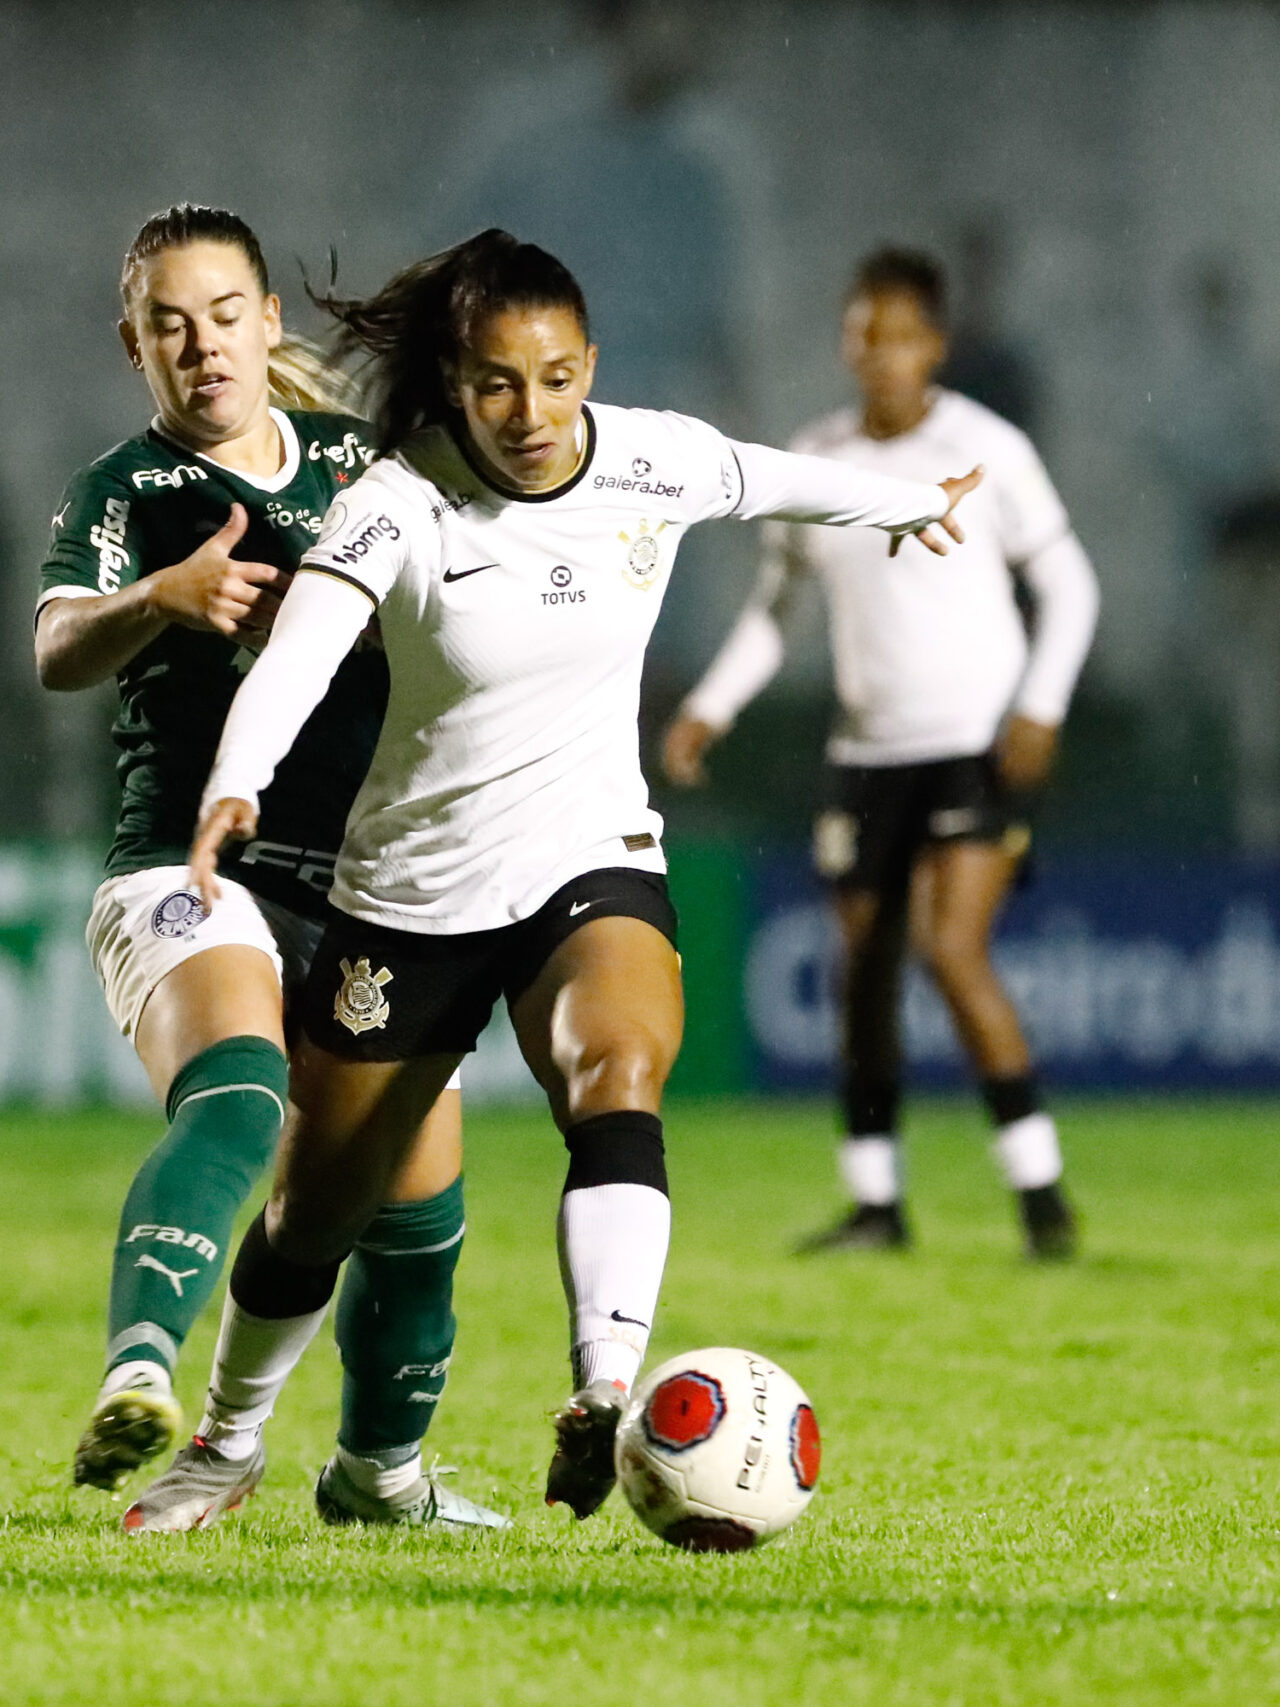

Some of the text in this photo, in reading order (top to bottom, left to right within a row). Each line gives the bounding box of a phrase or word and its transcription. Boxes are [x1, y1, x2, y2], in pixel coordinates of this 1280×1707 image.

[90, 497, 131, 596] crefisa
[342, 514, 401, 558] bmg
[541, 590, 586, 605] TOTVS
